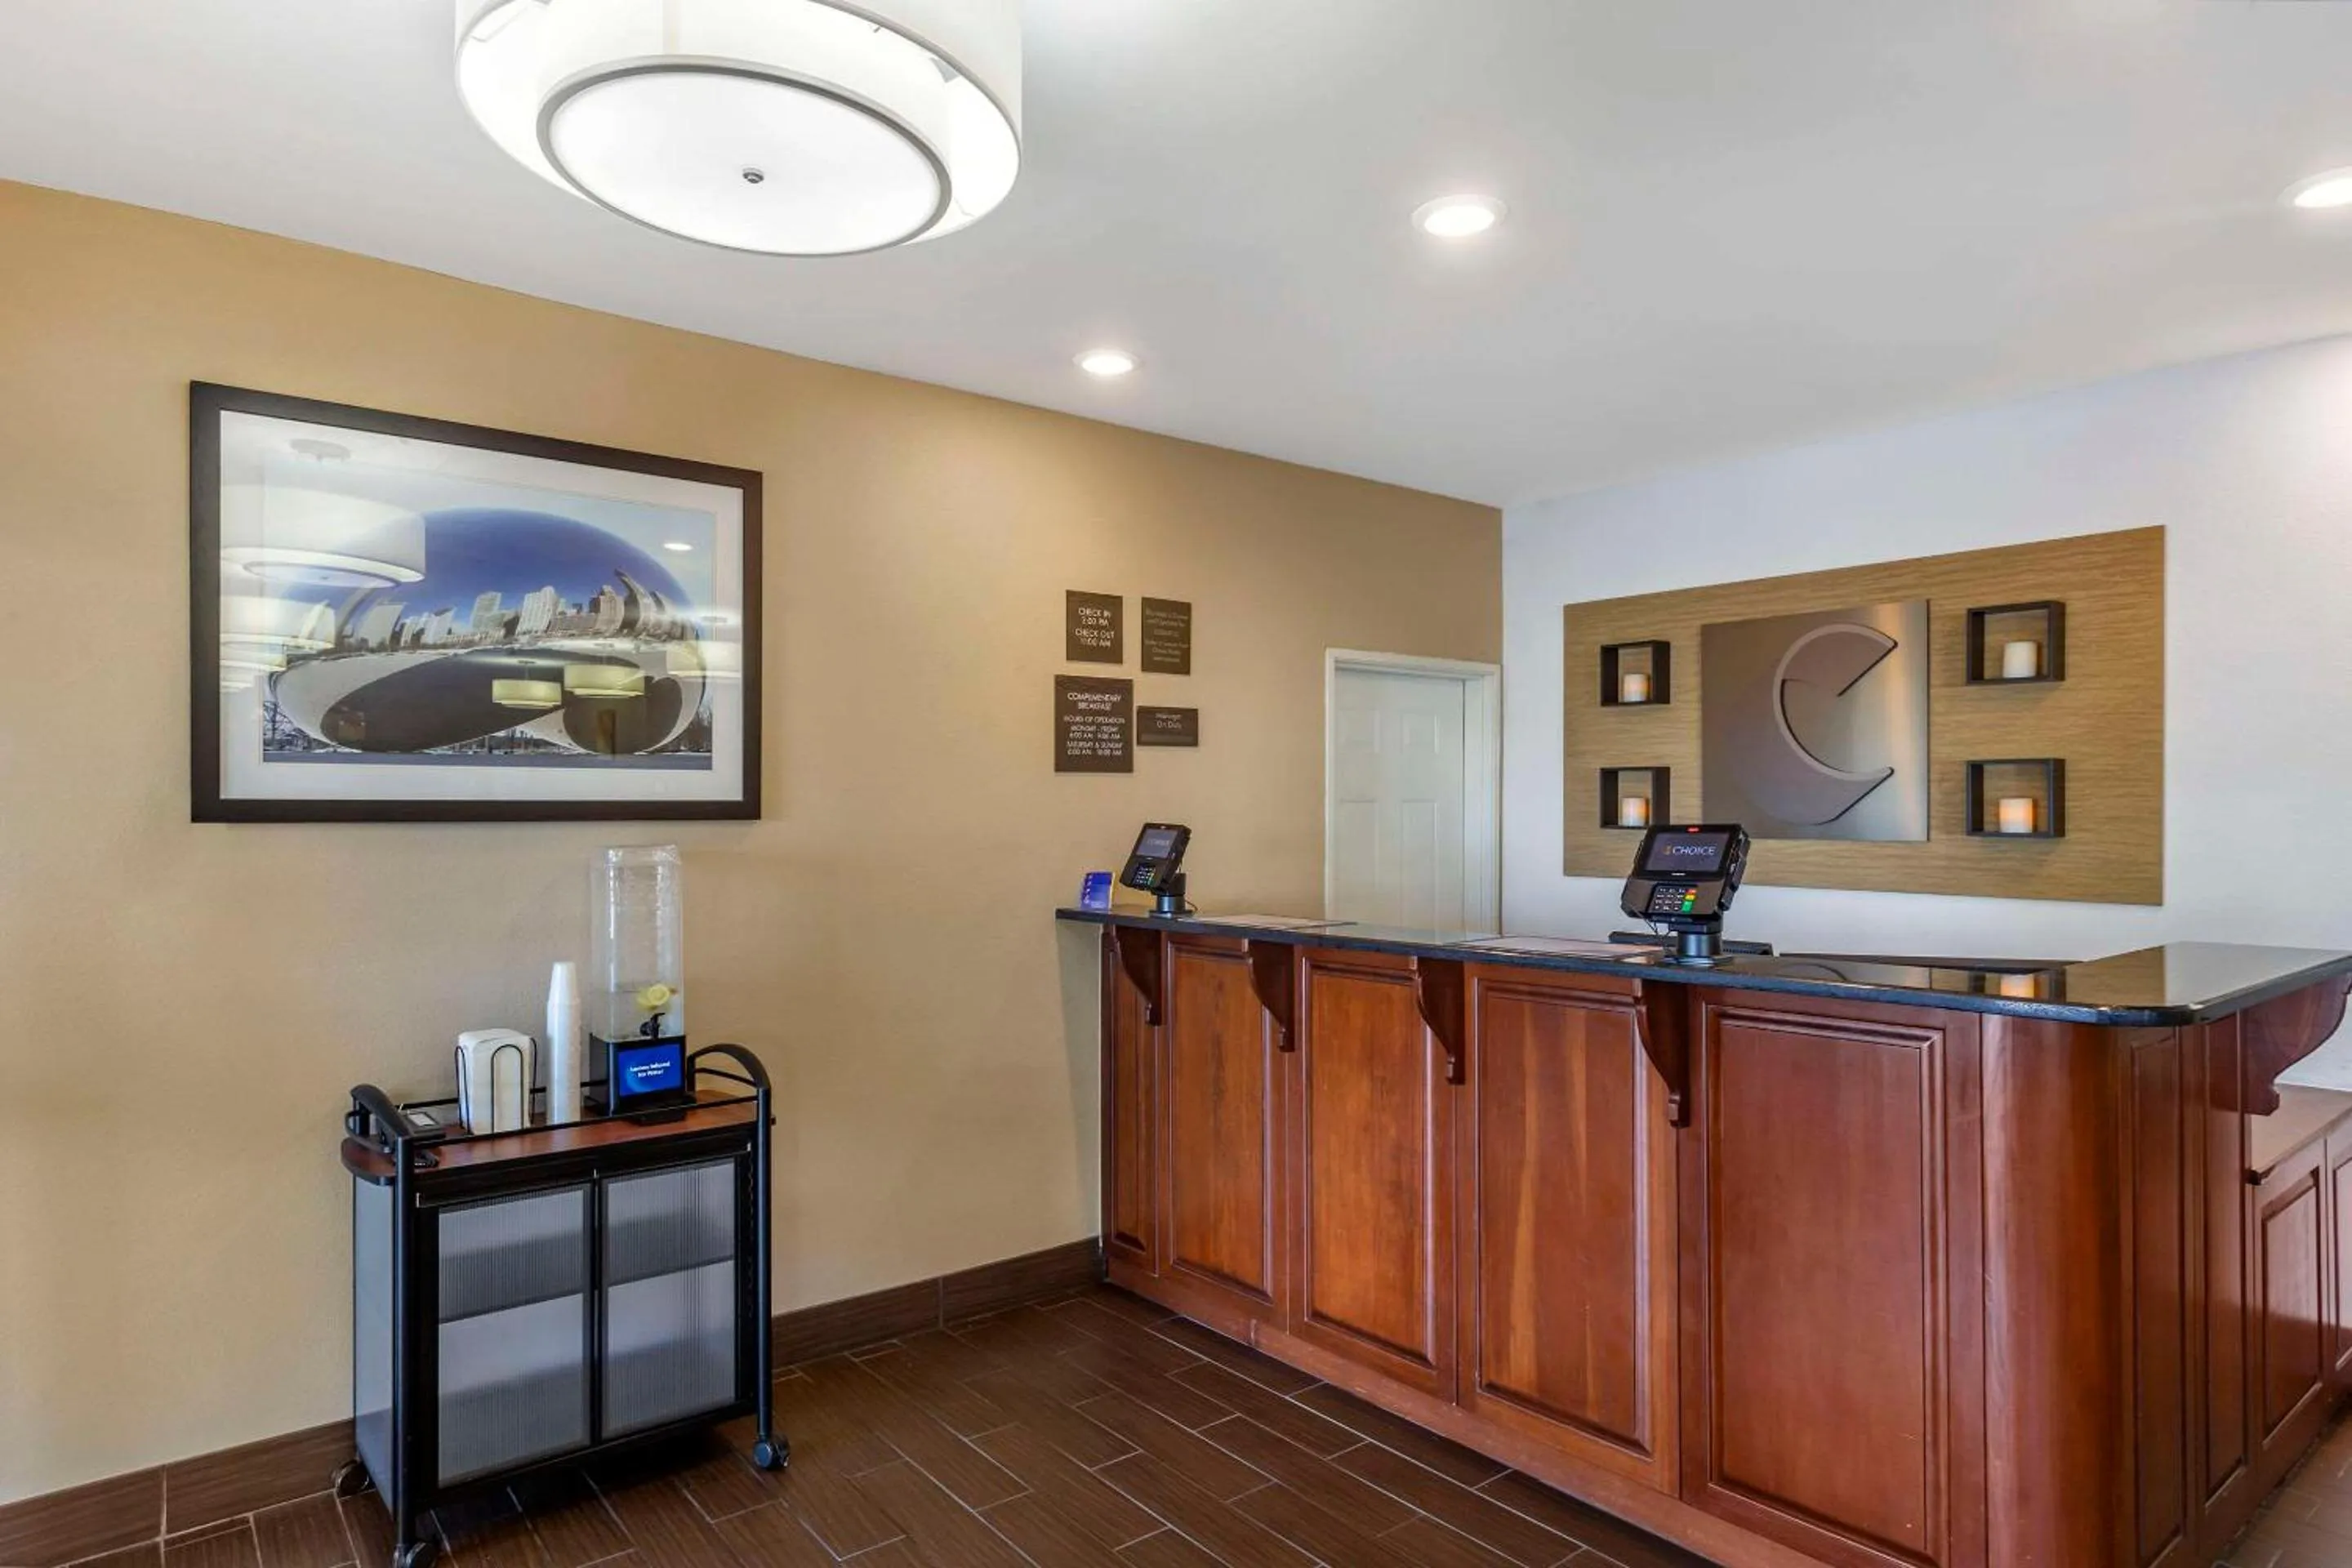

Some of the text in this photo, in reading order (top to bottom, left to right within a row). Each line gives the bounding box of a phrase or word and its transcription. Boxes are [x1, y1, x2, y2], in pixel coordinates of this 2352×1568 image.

[1078, 607, 1102, 617] CHECK
[1075, 627, 1115, 639] CHECK OUT
[1067, 692, 1121, 702] COMPLIMENTARY
[1078, 702, 1112, 711] BREAKFAST
[1672, 845, 1717, 856] CHOICE
